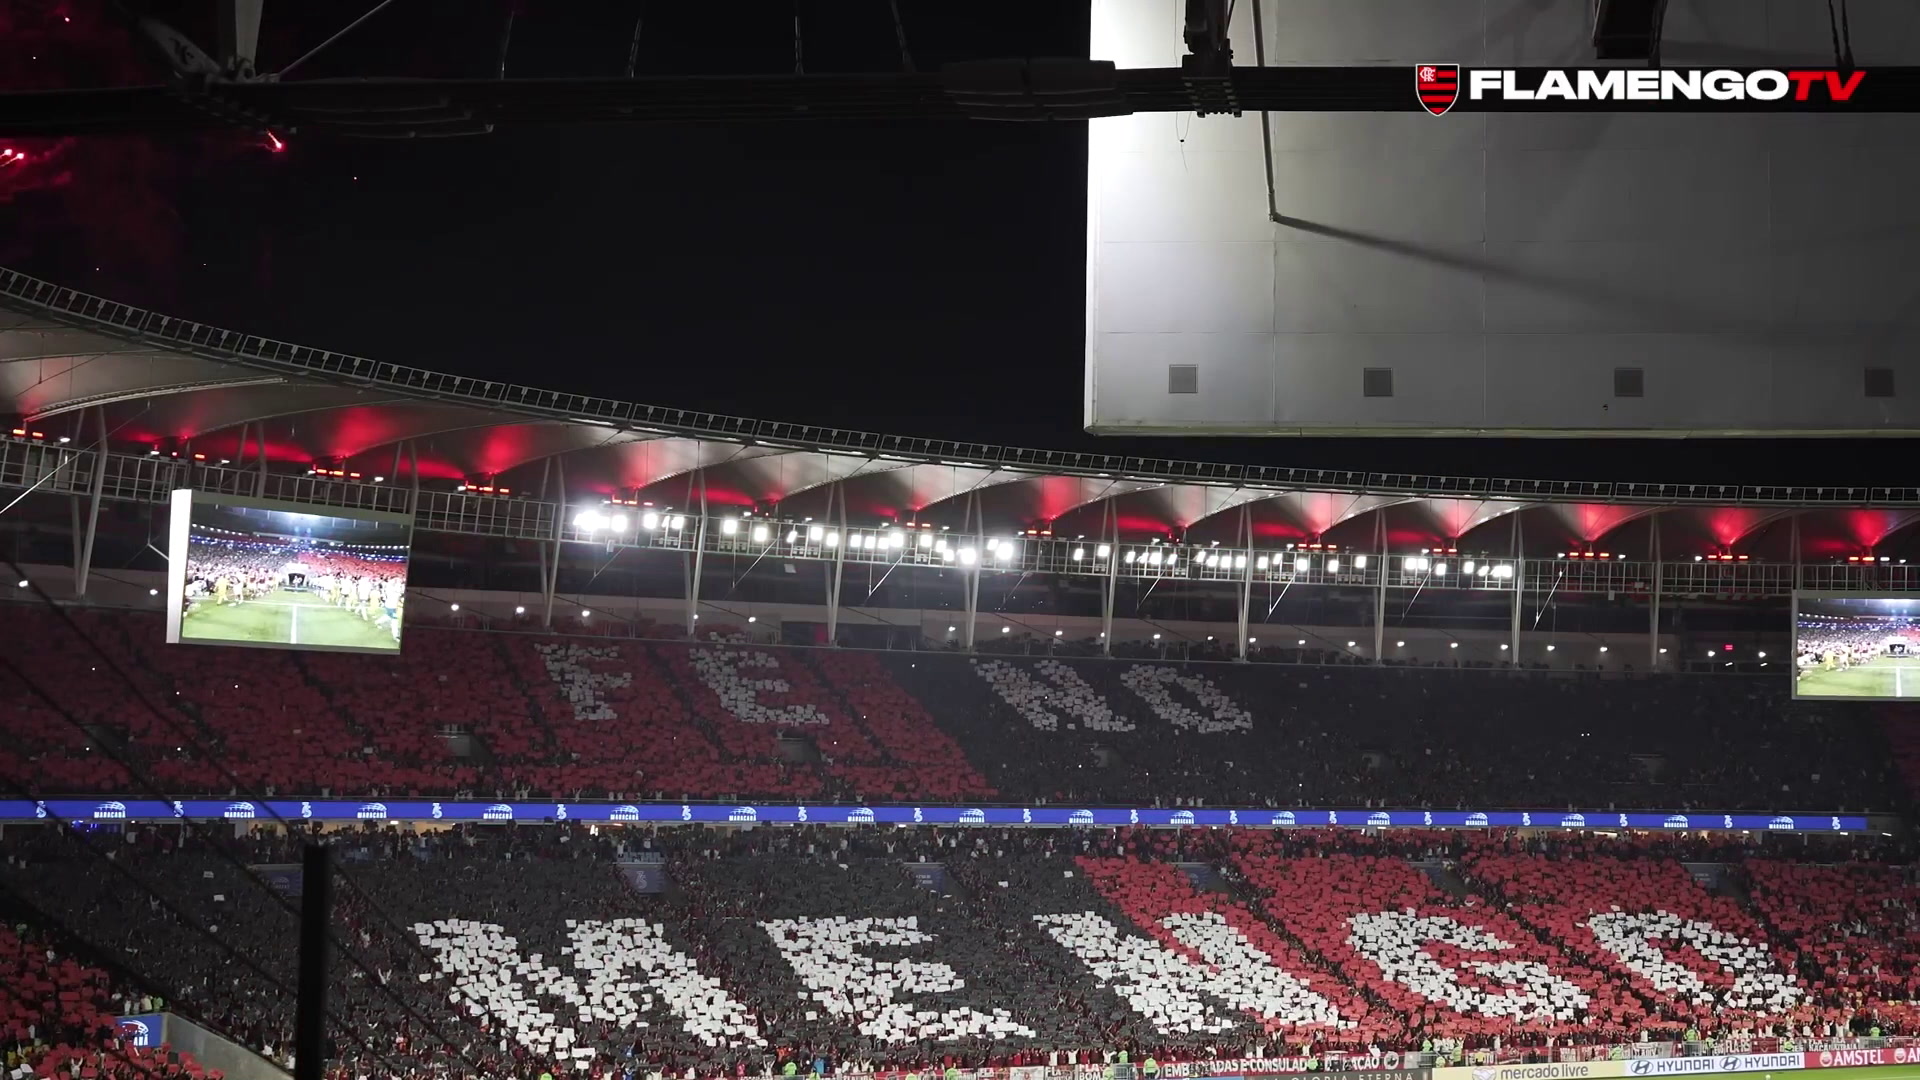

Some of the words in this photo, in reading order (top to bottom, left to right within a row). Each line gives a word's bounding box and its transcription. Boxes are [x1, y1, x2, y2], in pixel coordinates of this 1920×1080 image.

[410, 906, 1804, 1062] MENGO
[1745, 1055, 1800, 1068] HYUNDAI
[1834, 1049, 1885, 1066] AMSTEL
[1500, 1066, 1559, 1079] mercado
[1562, 1064, 1589, 1077] livre
[1657, 1059, 1714, 1072] HYUNDAI
